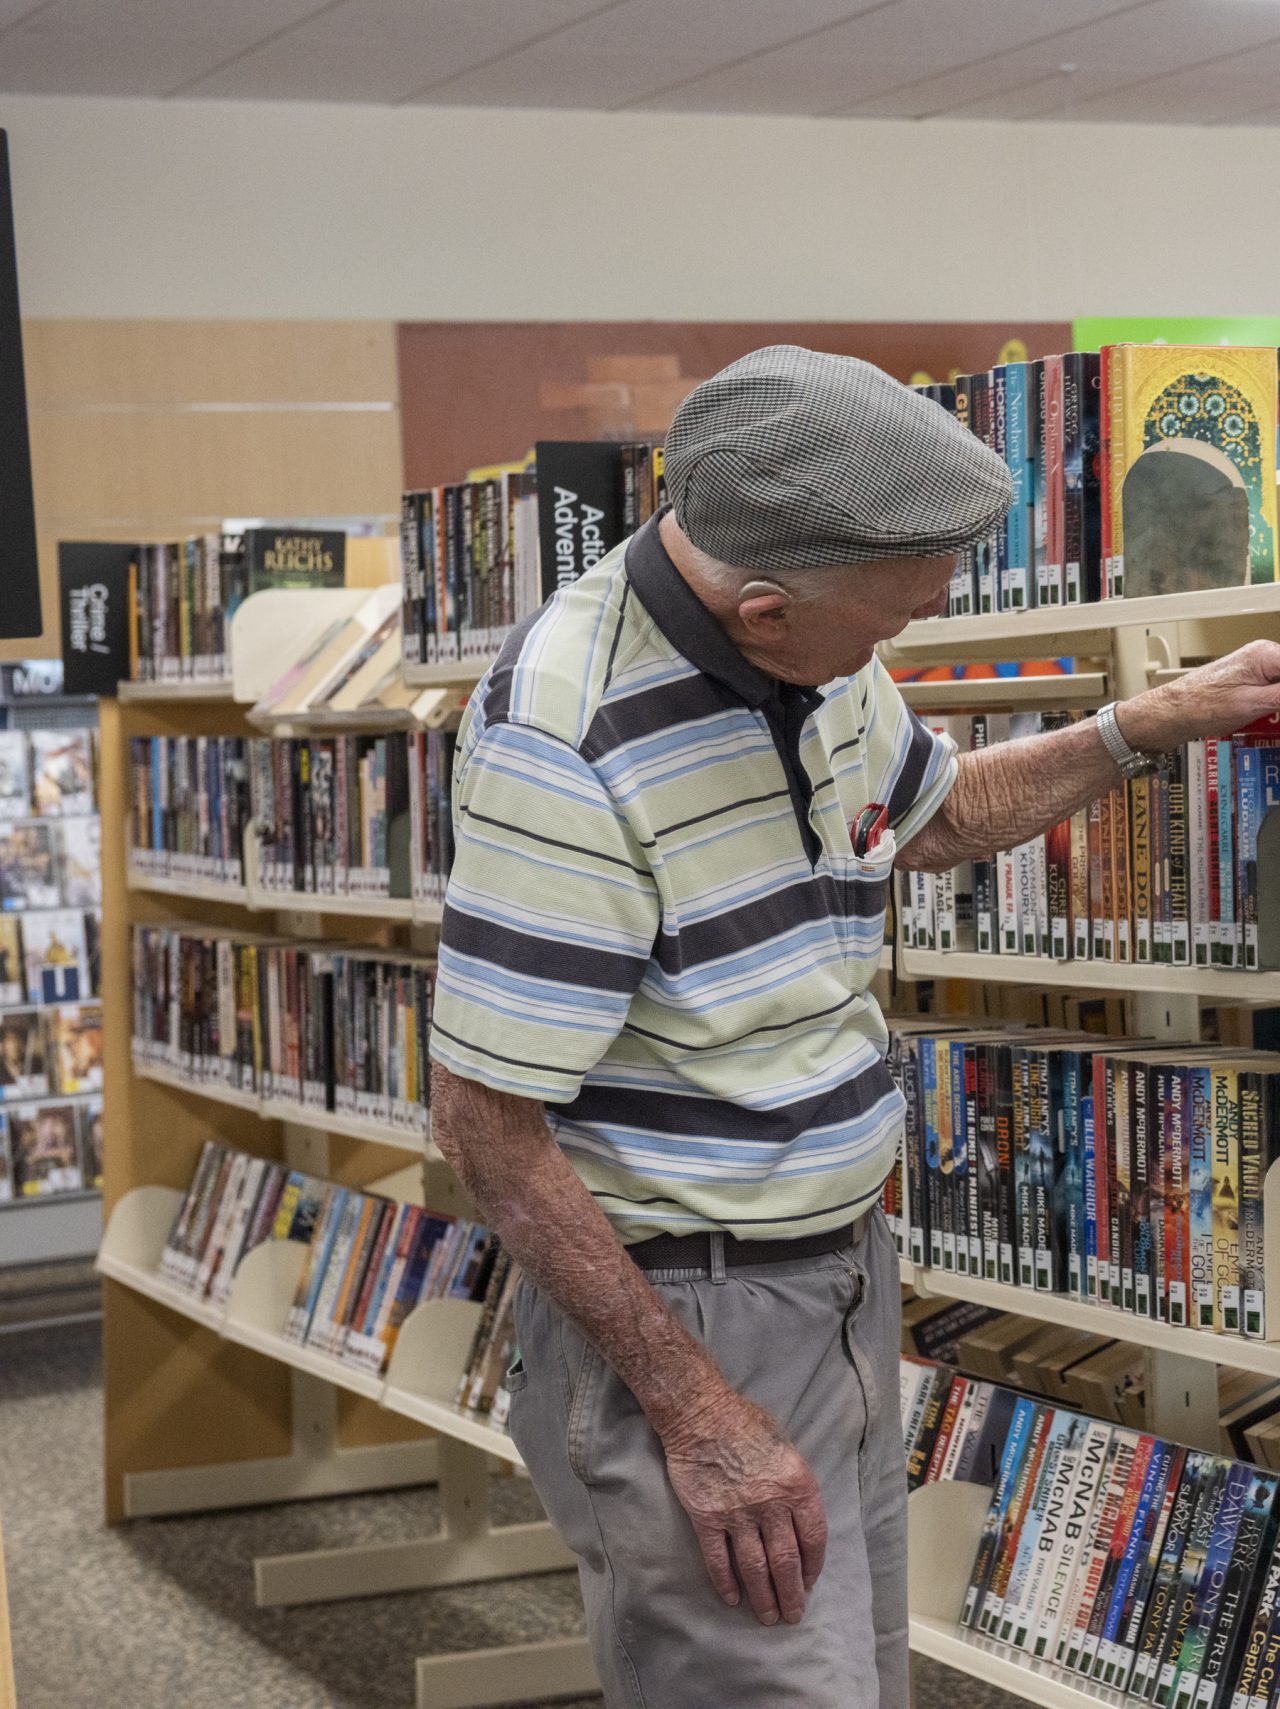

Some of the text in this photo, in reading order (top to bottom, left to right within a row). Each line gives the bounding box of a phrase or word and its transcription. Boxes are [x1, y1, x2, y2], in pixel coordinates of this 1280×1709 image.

[1011, 392, 1023, 463] Nowhere
[553, 486, 580, 590] Advent
[580, 504, 606, 573] Actio
[1169, 783, 1185, 855] OUR KIND
[1240, 788, 1249, 859] LUDLUM
[1020, 852, 1029, 916] KHOURY
[967, 1100, 976, 1123] THE
[1136, 1070, 1145, 1099] ANDY
[1171, 1075, 1181, 1109] ANDY
[967, 1126, 977, 1171] NEMESIS
[1215, 1076, 1229, 1166] McDERMOTT
[1228, 1100, 1239, 1141] ANDY
[1241, 1090, 1259, 1150] SACRED
[1021, 1186, 1029, 1214] MIKE
[1084, 1119, 1096, 1221] BLUE WARRIOR
[968, 1175, 978, 1237] MANIFEST
[1037, 1186, 1046, 1250] MIKE MADE
[1256, 1237, 1264, 1274] ANDY
[918, 1375, 932, 1406] MARK
[1012, 1409, 1026, 1437] ANDY
[1110, 1442, 1136, 1488] ANDY
[1038, 1462, 1074, 1553] McNAB
[1044, 1438, 1105, 1619] McNAB SILENCE
[1115, 1453, 1162, 1601] VINCE FLYNN TOTAL
[1082, 1557, 1105, 1599] BRUTE
[1128, 1562, 1142, 1597] NATASHA
[1201, 1481, 1245, 1620] DAWN TONY
[1150, 1585, 1168, 1629] TONY
[1177, 1592, 1197, 1638] TONY
[1203, 1590, 1242, 1682] THE PREY
[1238, 1629, 1268, 1696] Captive
[1258, 1665, 1275, 1701] Cull
